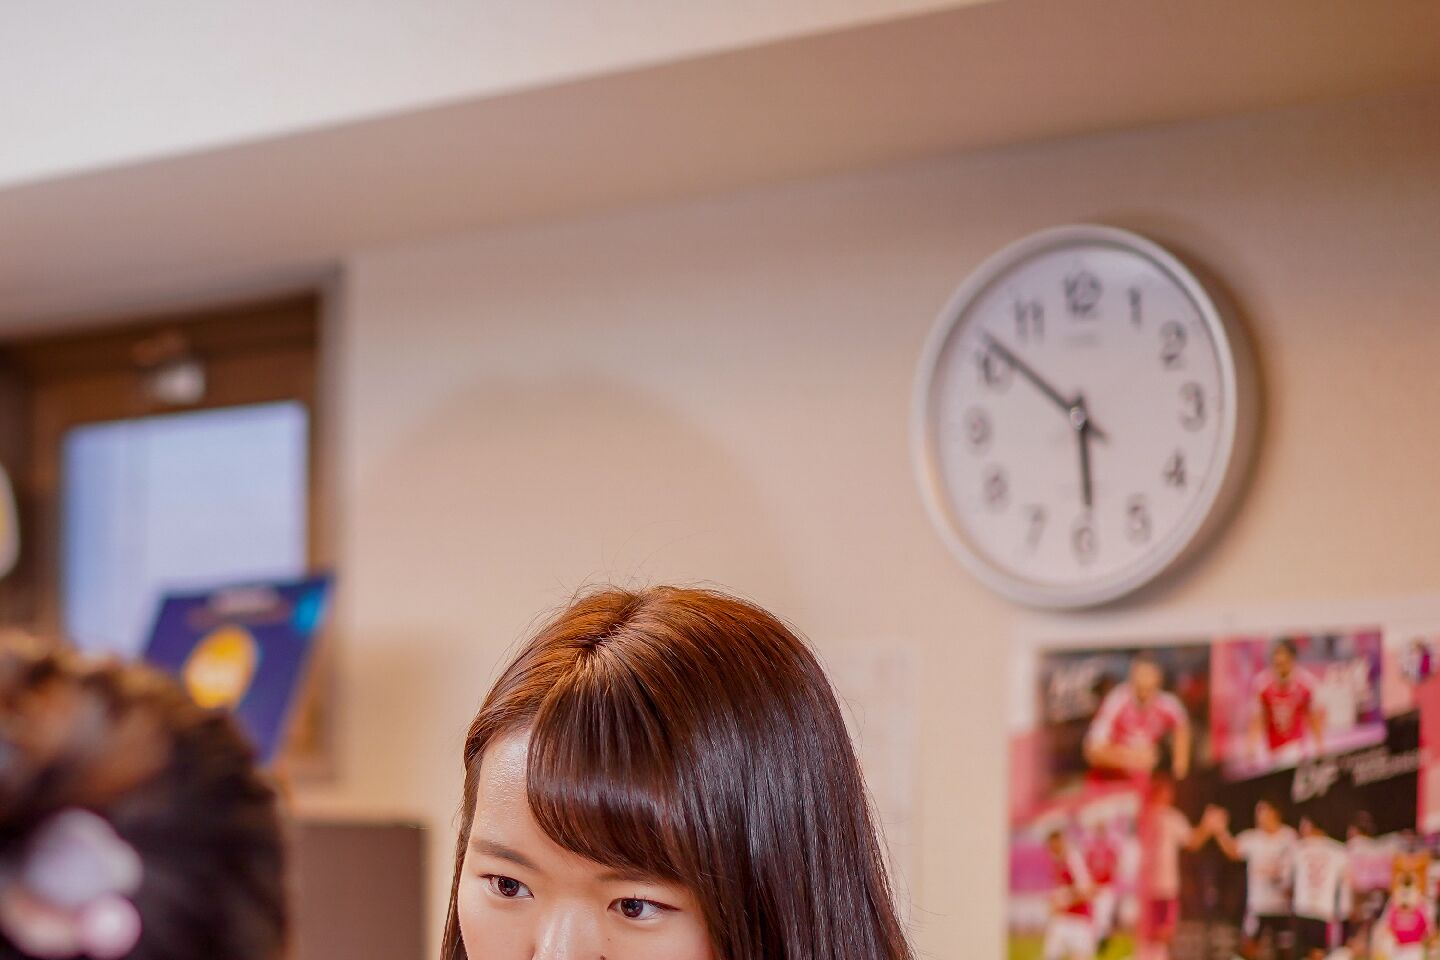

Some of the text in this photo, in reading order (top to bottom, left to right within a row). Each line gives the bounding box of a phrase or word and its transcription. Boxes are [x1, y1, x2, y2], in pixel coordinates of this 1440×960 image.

[1064, 271, 1102, 319] 12
[1128, 286, 1142, 331] 1
[1014, 298, 1046, 345] 11
[1161, 320, 1186, 371] 2
[966, 406, 991, 453] 9
[1178, 382, 1205, 432] 3
[984, 466, 1009, 511] 8
[1163, 447, 1187, 489] 4
[1024, 503, 1047, 553] 7
[1071, 516, 1098, 564] 6
[1126, 495, 1152, 544] 5
